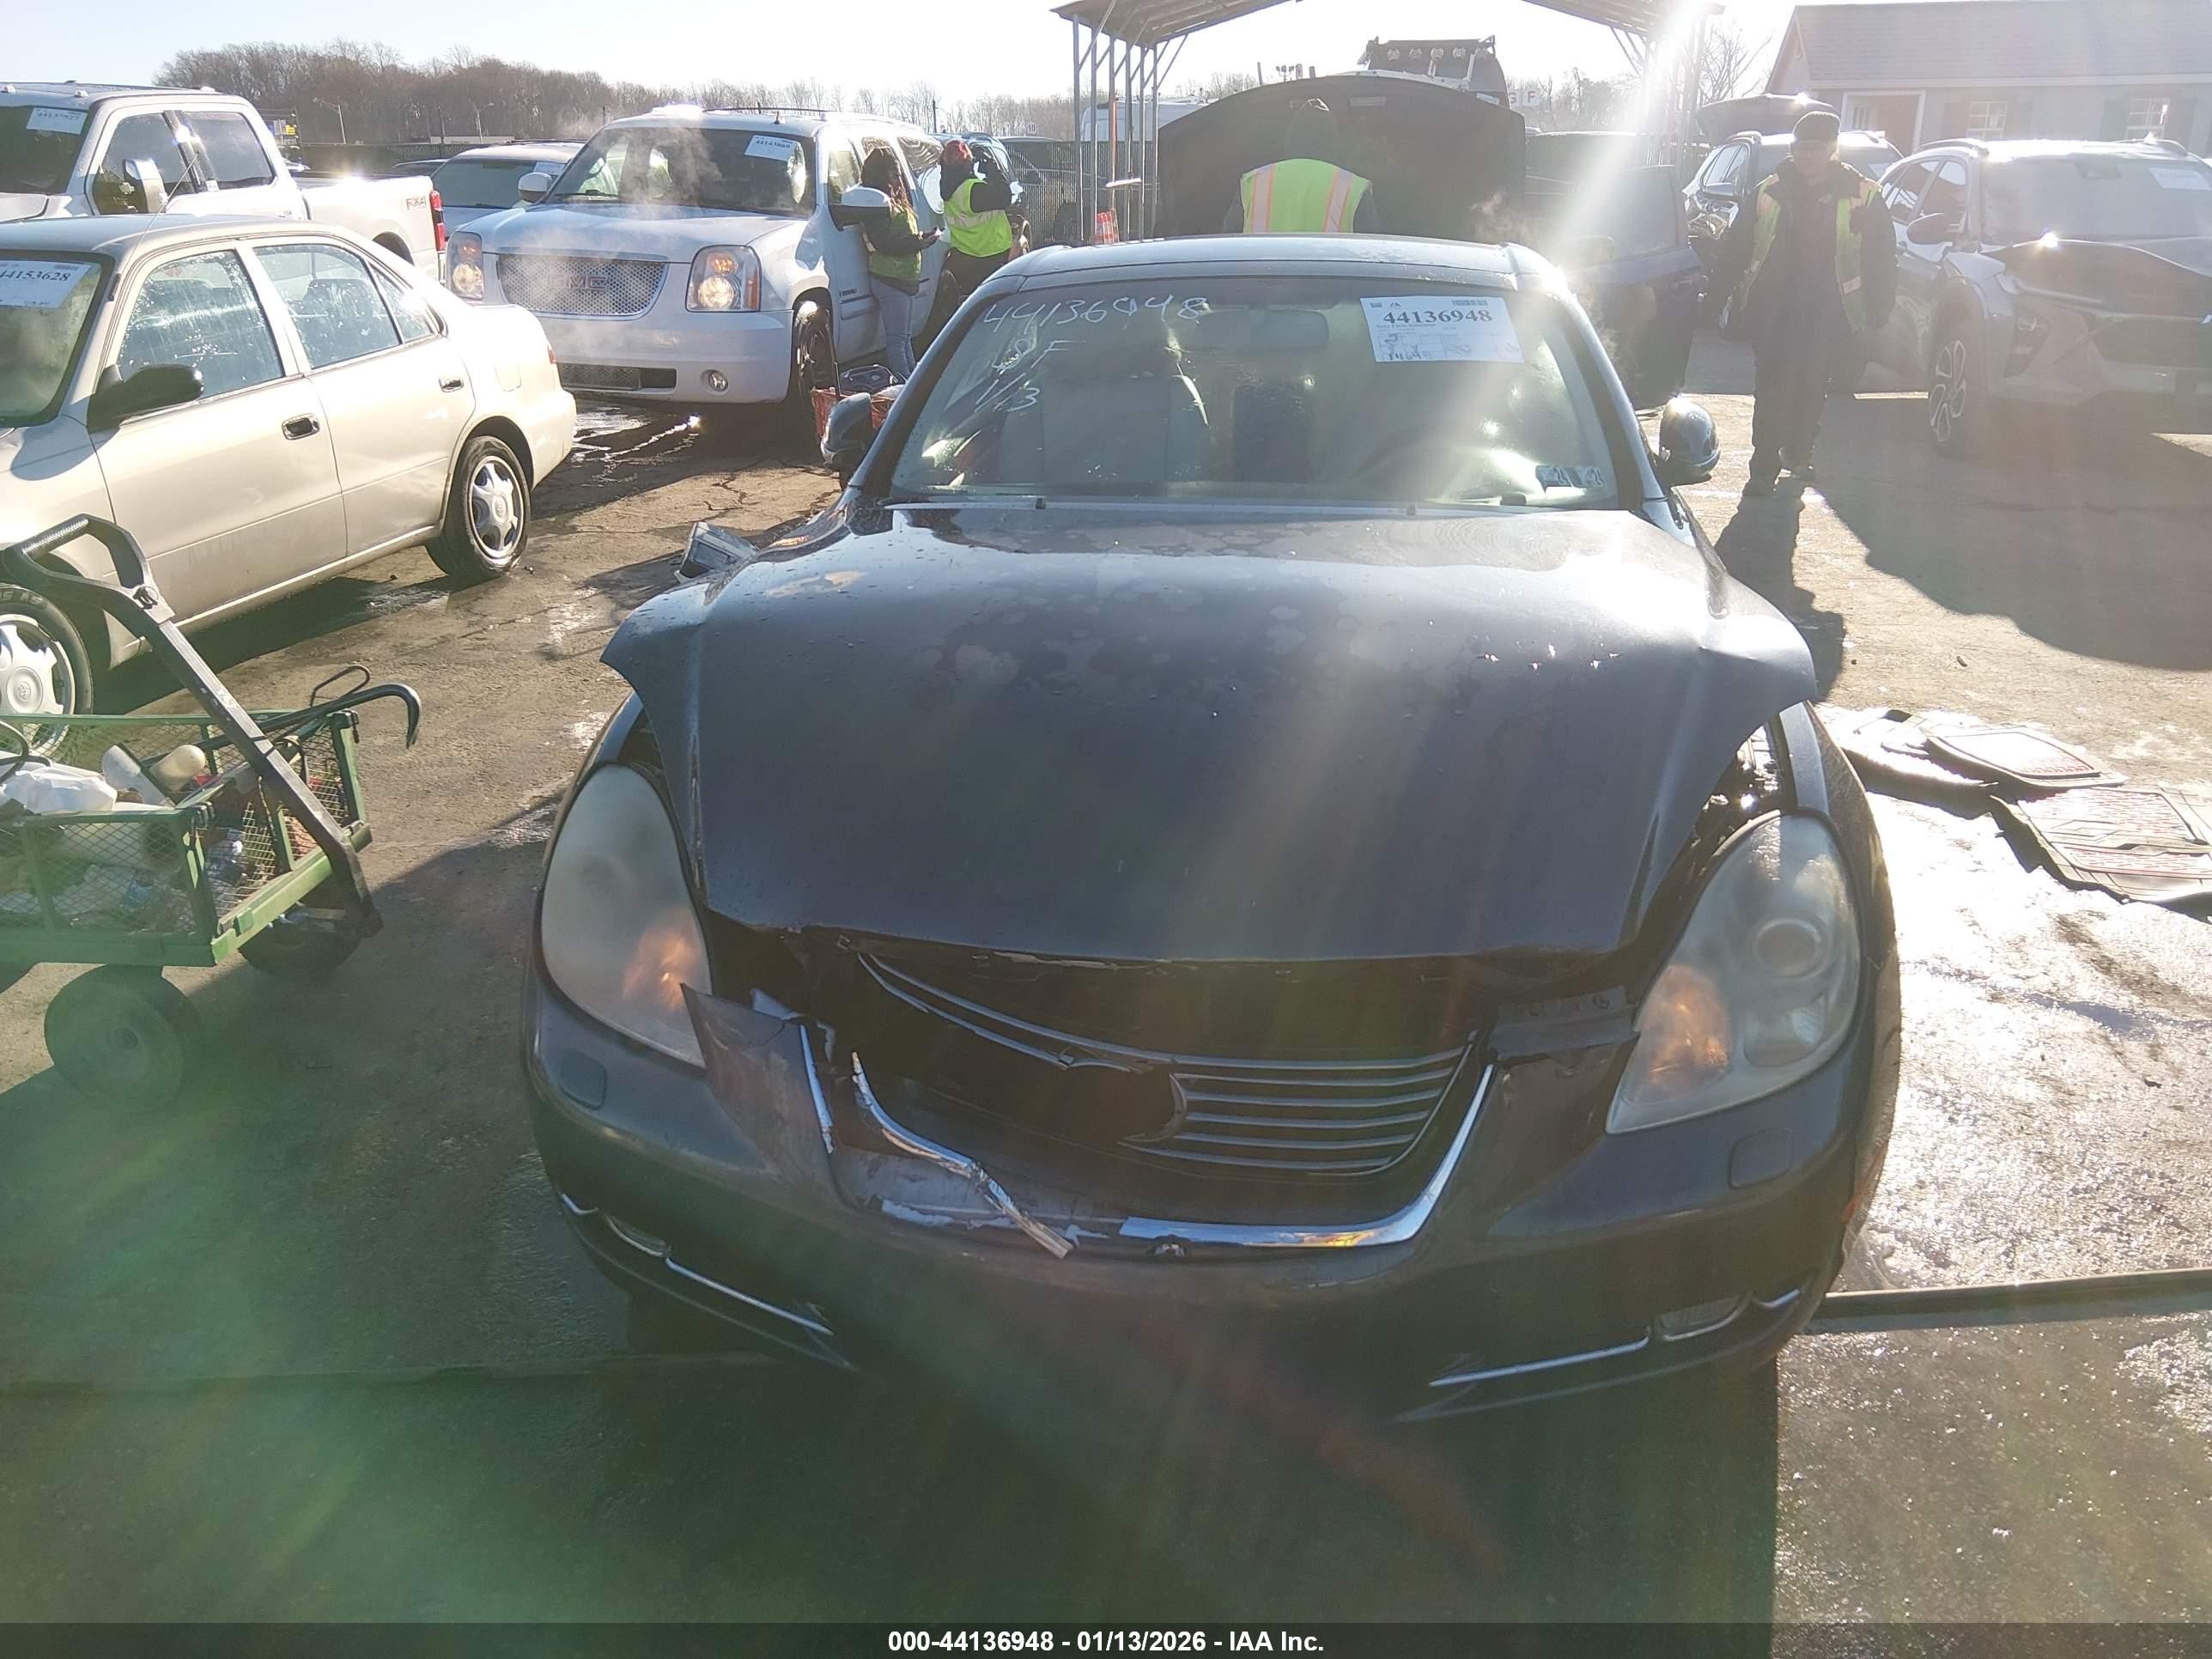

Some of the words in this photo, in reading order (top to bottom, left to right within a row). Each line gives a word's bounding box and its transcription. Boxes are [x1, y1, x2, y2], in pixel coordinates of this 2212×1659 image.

[1528, 91, 1535, 103] F
[405, 194, 427, 211] FX4
[548, 274, 607, 291] GMC
[1382, 308, 1493, 325] 44136948
